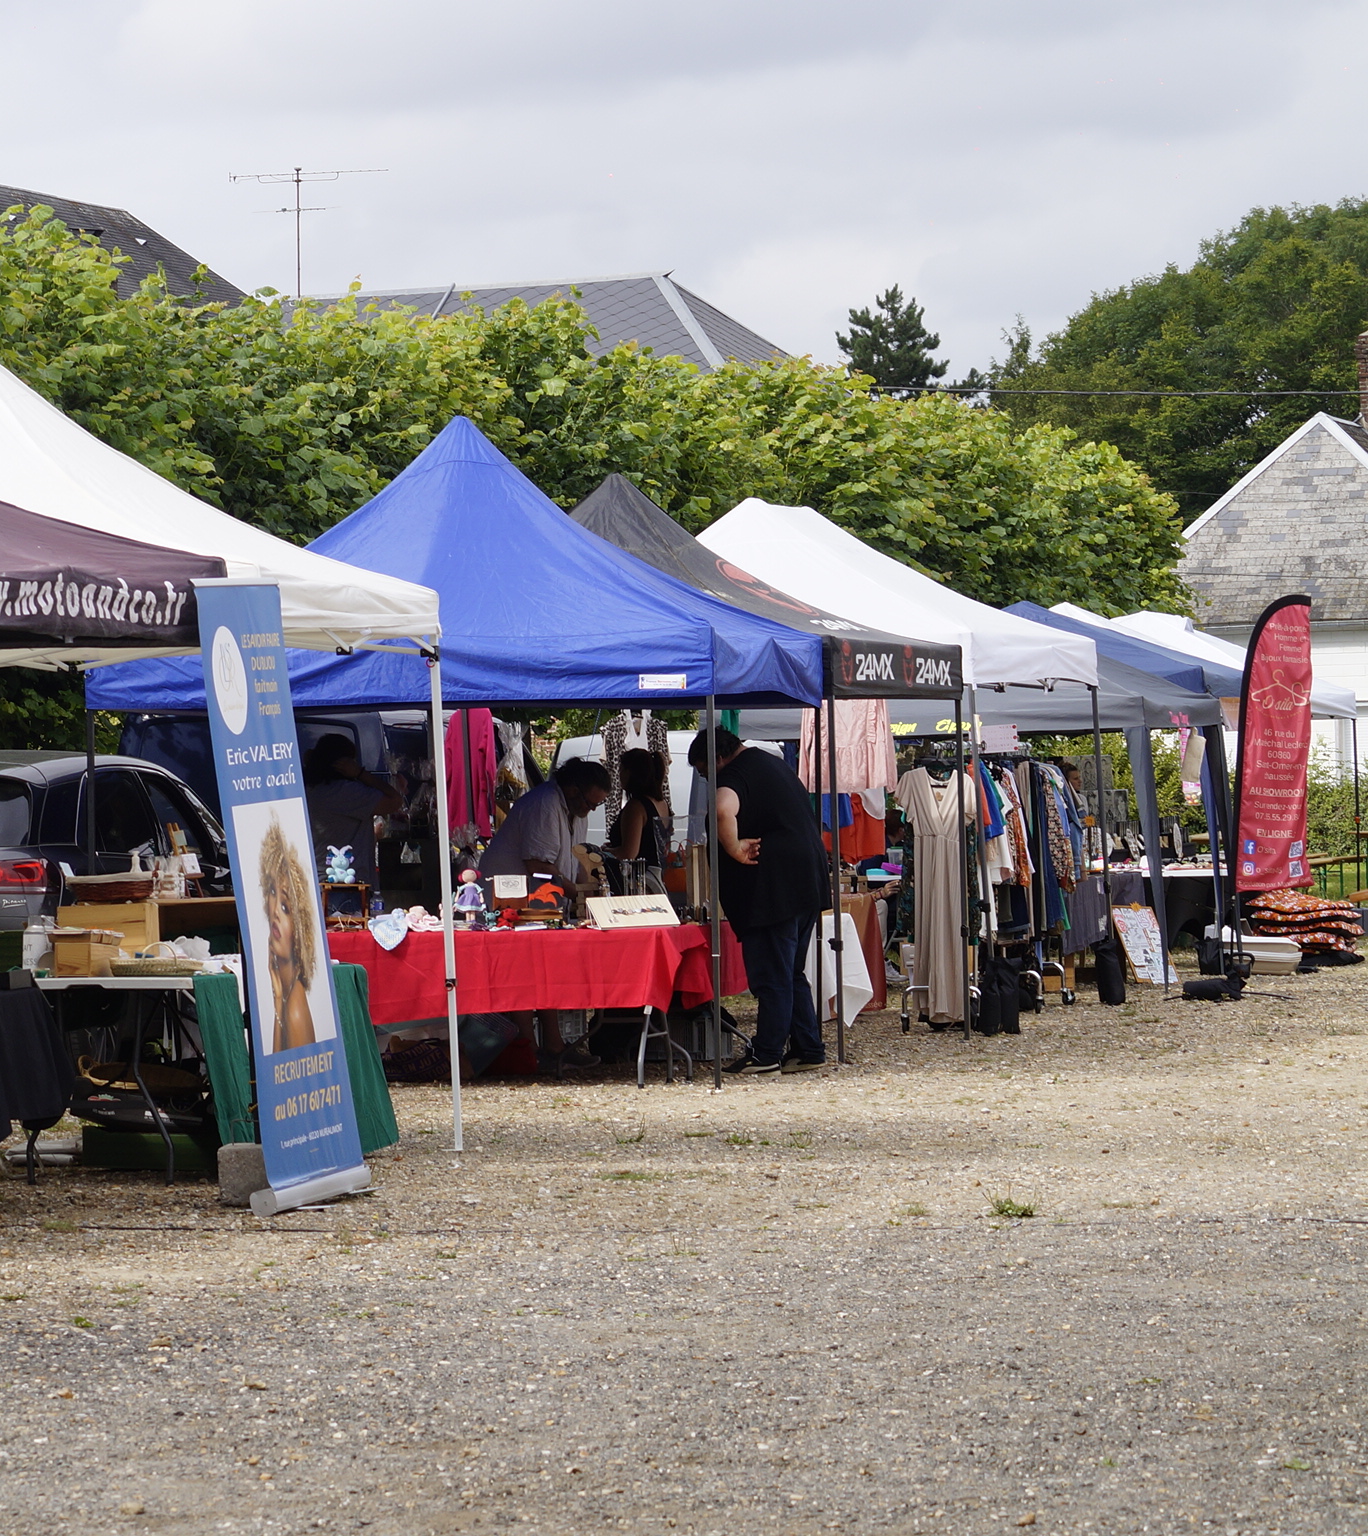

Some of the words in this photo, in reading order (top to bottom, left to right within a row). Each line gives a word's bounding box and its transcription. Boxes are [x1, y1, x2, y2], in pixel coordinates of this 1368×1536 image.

[855, 653, 895, 681] 24MX
[916, 657, 952, 687] 24MX
[889, 721, 918, 736] sign
[1274, 730, 1285, 738] rue
[1285, 730, 1296, 739] du
[226, 747, 249, 765] Eric
[249, 741, 293, 763] VALERY
[232, 775, 262, 791] votre
[266, 763, 296, 787] coach
[1249, 786, 1262, 796] AU
[274, 1050, 334, 1085] RECRUTEMENT
[275, 1103, 286, 1121] au
[287, 1095, 298, 1118] 06
[298, 1092, 308, 1114] 17
